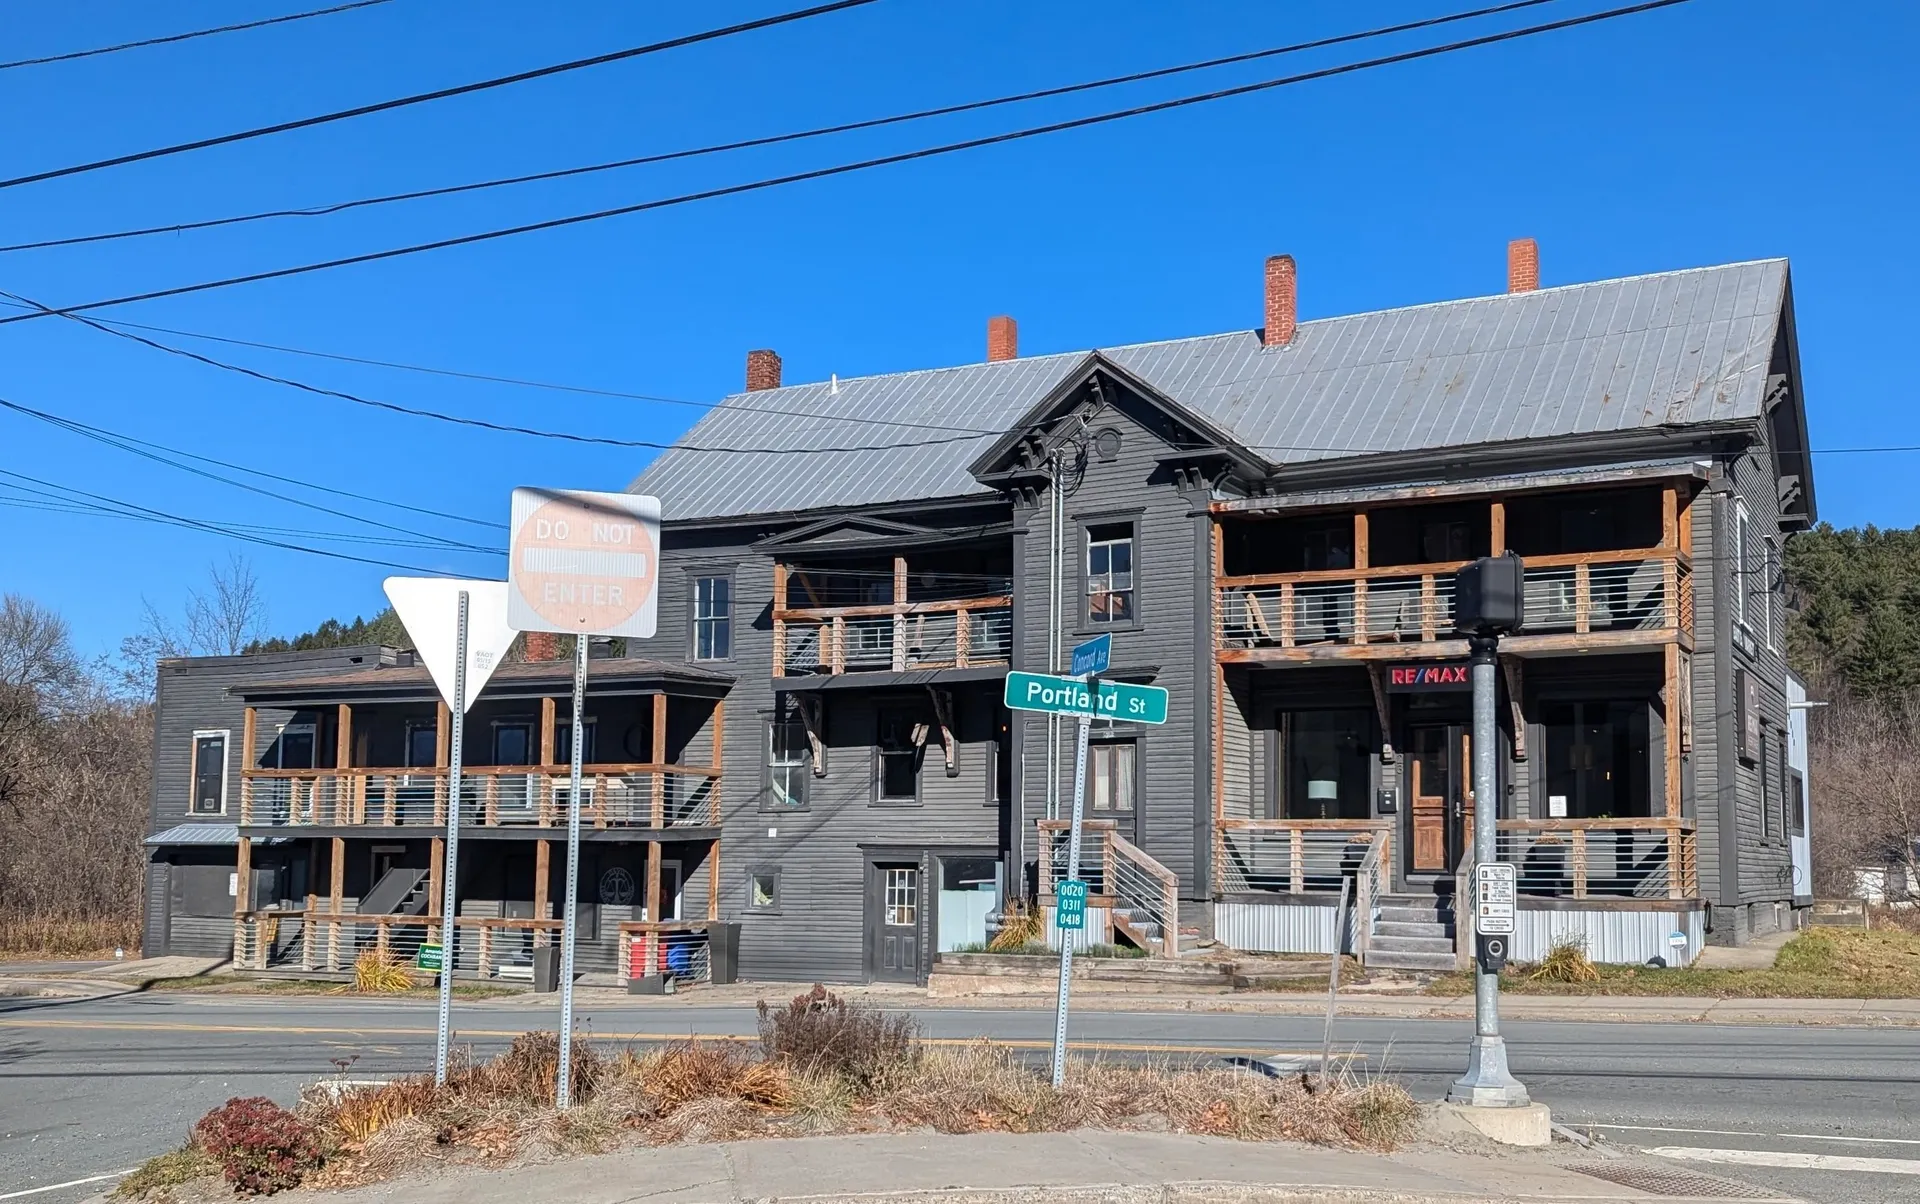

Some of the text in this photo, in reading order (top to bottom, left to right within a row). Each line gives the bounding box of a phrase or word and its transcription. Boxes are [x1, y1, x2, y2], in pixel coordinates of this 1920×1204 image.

[535, 518, 636, 545] DO NOT
[543, 582, 623, 606] ENTER
[1074, 649, 1106, 672] Concord Ave
[1391, 667, 1467, 684] RE/MAX
[1027, 682, 1146, 714] Portland St
[1061, 885, 1083, 897] 0020
[1062, 899, 1081, 911] 0311
[1060, 913, 1081, 925] 0418
